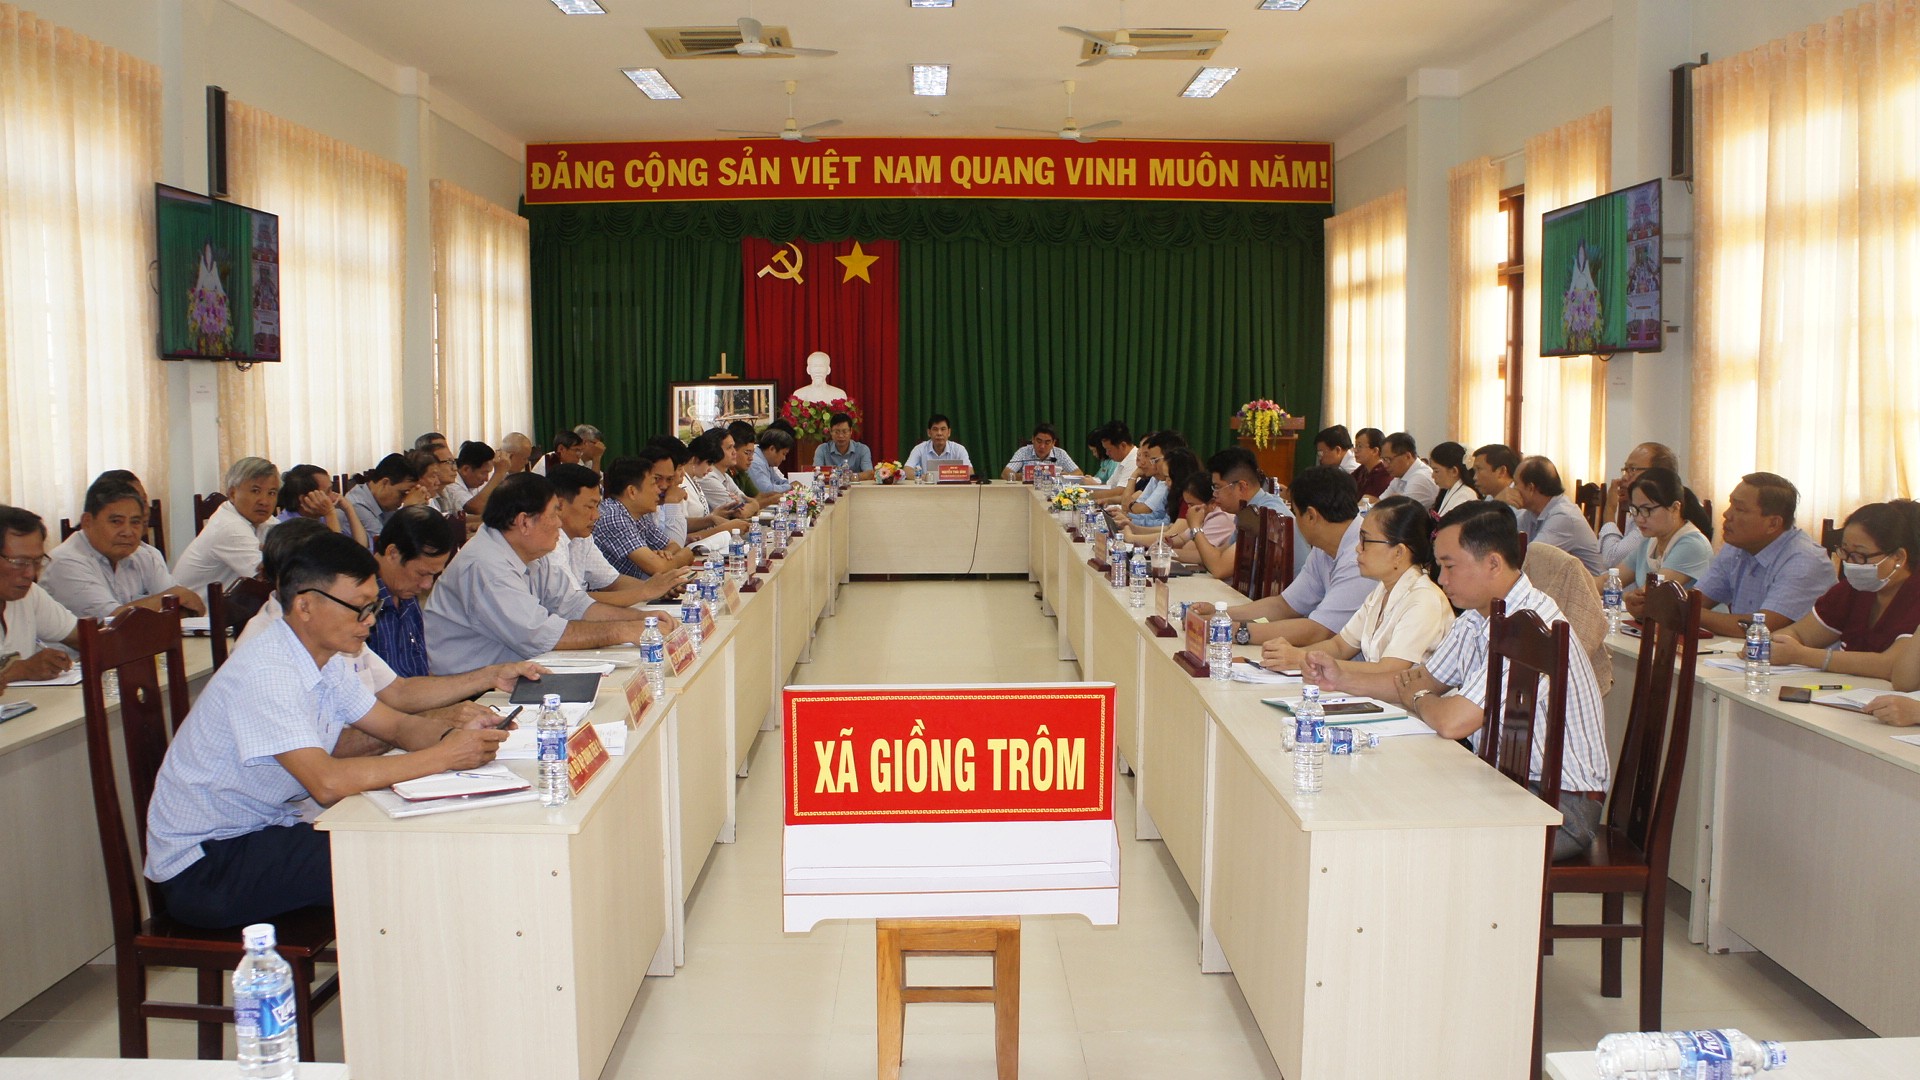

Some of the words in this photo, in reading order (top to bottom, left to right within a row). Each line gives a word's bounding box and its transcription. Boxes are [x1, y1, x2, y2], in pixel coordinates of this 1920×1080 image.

[531, 150, 615, 190] ĐẢNG
[624, 151, 708, 193] CỘNG
[718, 146, 780, 186] SẢN
[791, 148, 862, 190] VIỆT
[874, 155, 942, 184] NAM
[950, 155, 1055, 190] QUANG
[1064, 157, 1137, 186] VINH
[1149, 151, 1239, 187] MUÔN
[1250, 154, 1328, 188] NĂM!
[814, 726, 859, 794] XÃ
[870, 718, 976, 793] GIỒNG
[987, 724, 1086, 792] TRÔM
